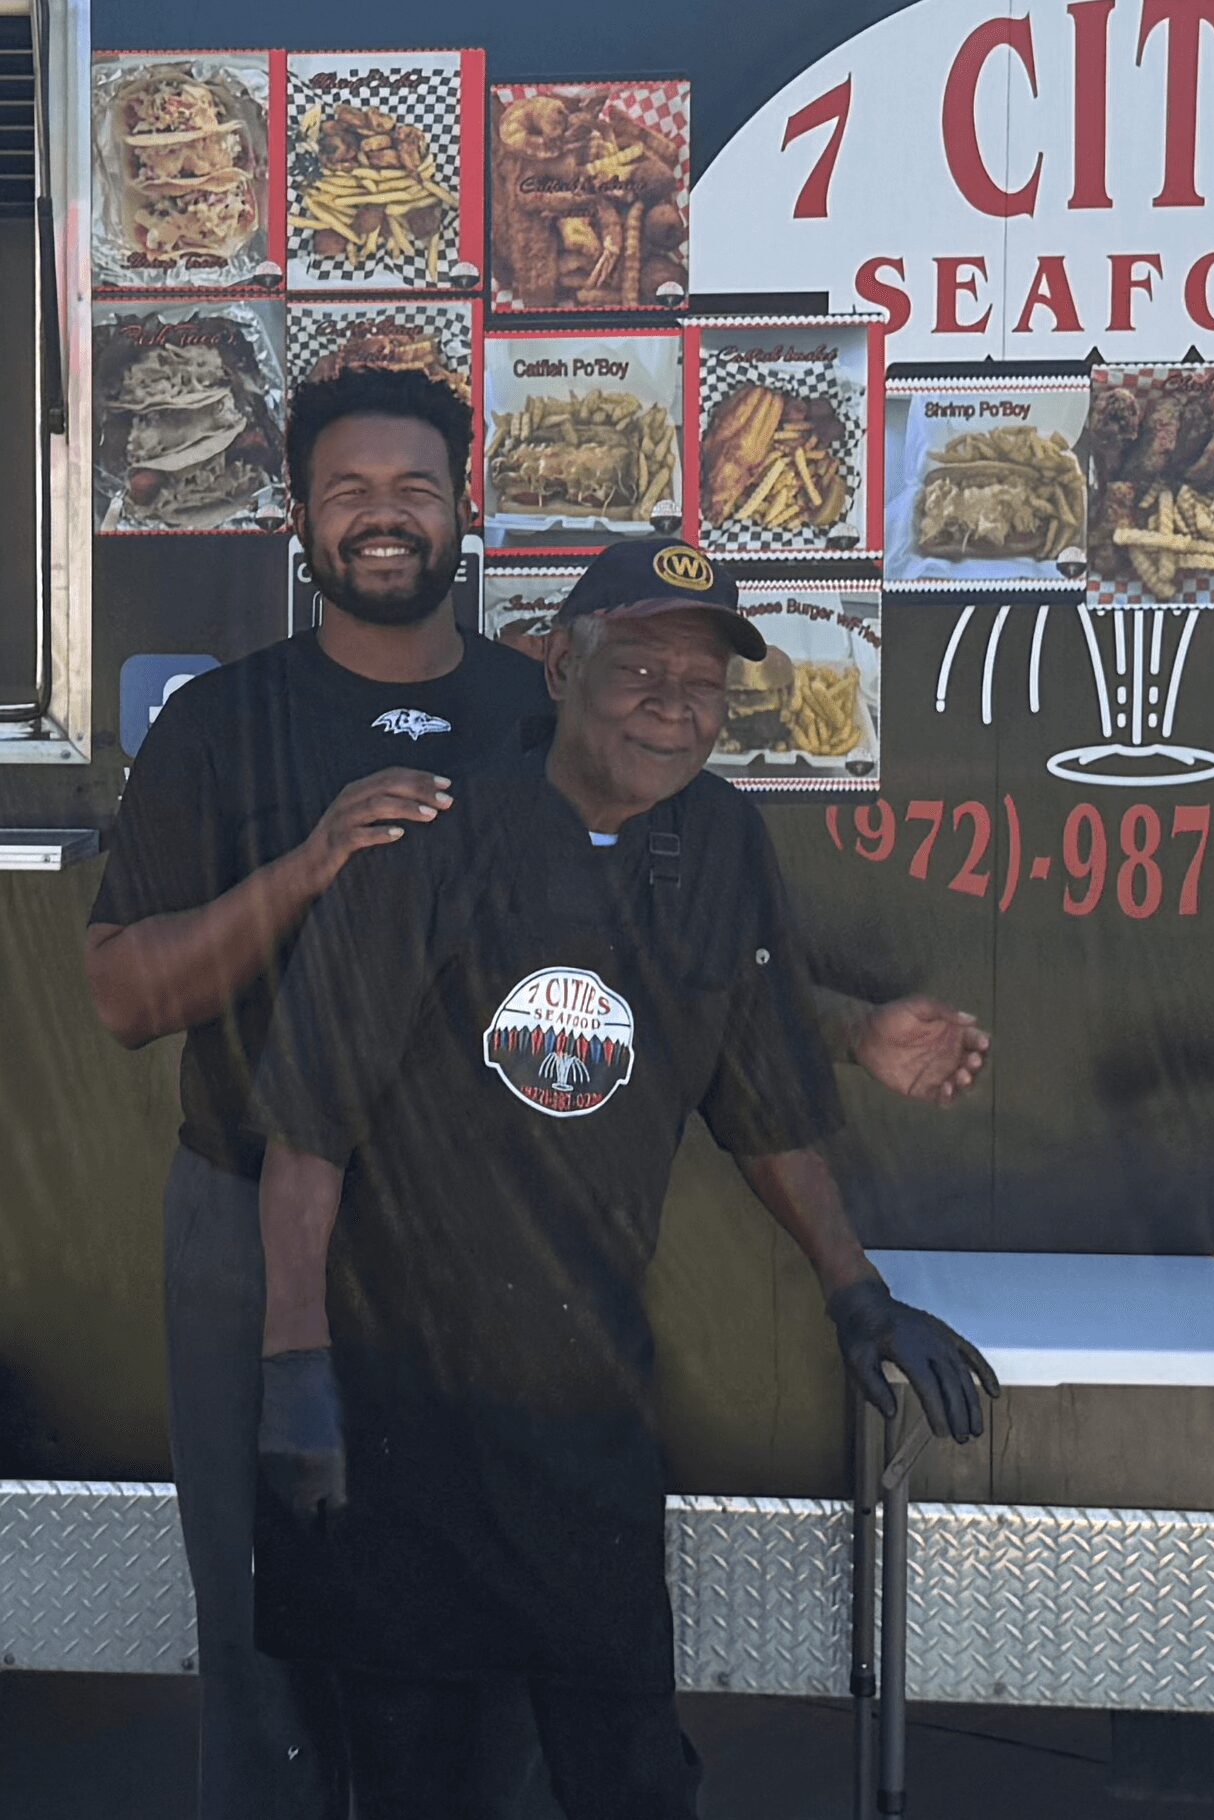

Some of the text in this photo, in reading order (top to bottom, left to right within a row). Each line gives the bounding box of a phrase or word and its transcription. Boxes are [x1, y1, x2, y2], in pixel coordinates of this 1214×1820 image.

[780, 71, 852, 219] 7
[513, 358, 568, 378] Catfish
[924, 402, 976, 420] Shrimp
[671, 555, 700, 579] W
[735, 600, 782, 618] heese
[786, 598, 834, 621] Burger
[528, 978, 611, 1016] 7 CITIES
